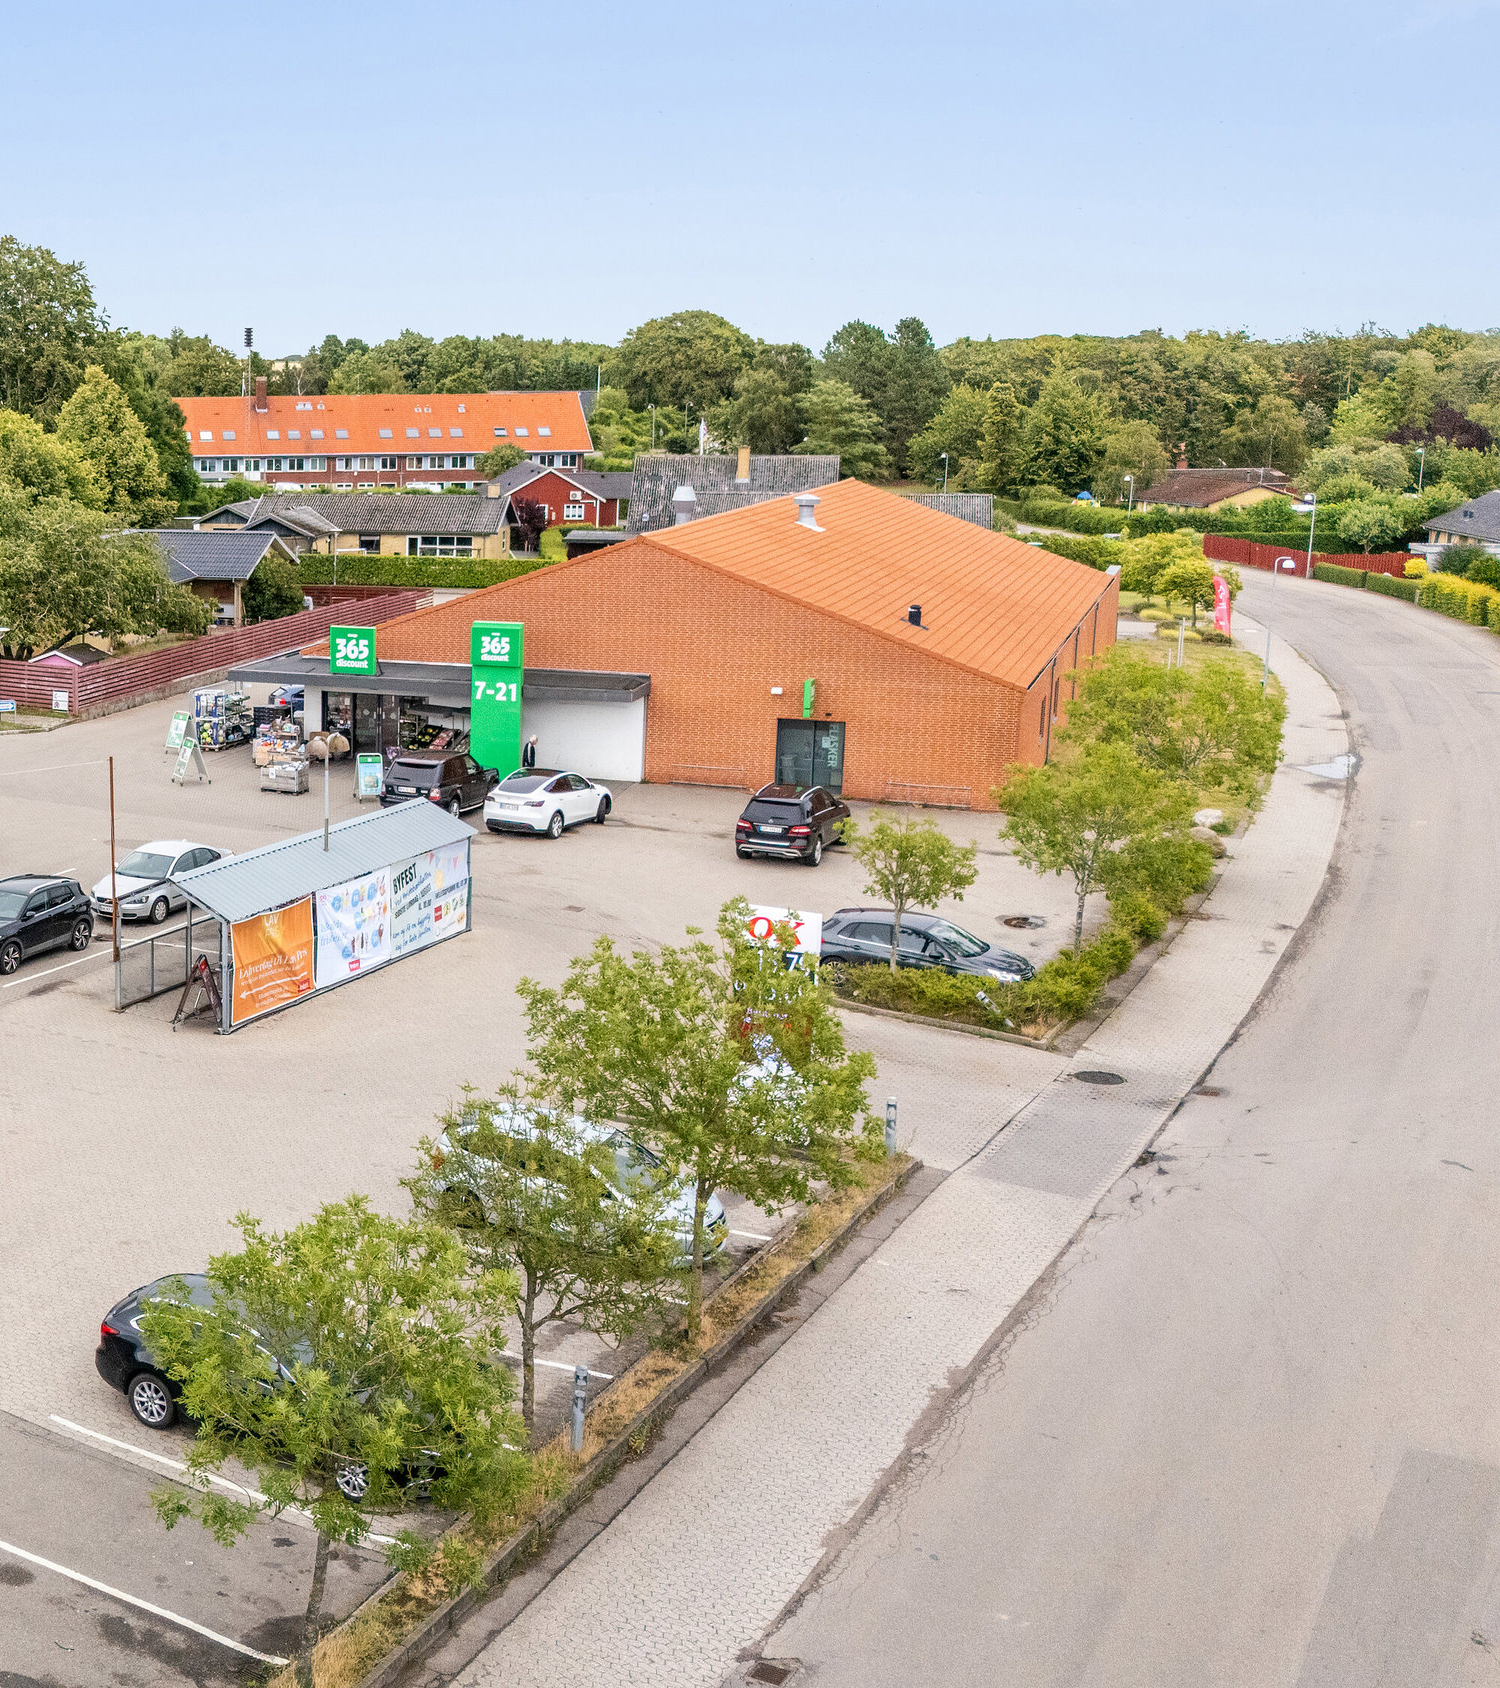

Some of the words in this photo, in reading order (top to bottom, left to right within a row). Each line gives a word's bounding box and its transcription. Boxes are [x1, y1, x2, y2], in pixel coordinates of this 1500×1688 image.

[336, 638, 369, 660] 365
[480, 636, 510, 654] 365
[336, 659, 368, 669] discount
[480, 653, 509, 662] discount
[474, 681, 517, 702] 7-21
[392, 863, 417, 895] BYFEST
[264, 913, 280, 927] LAV
